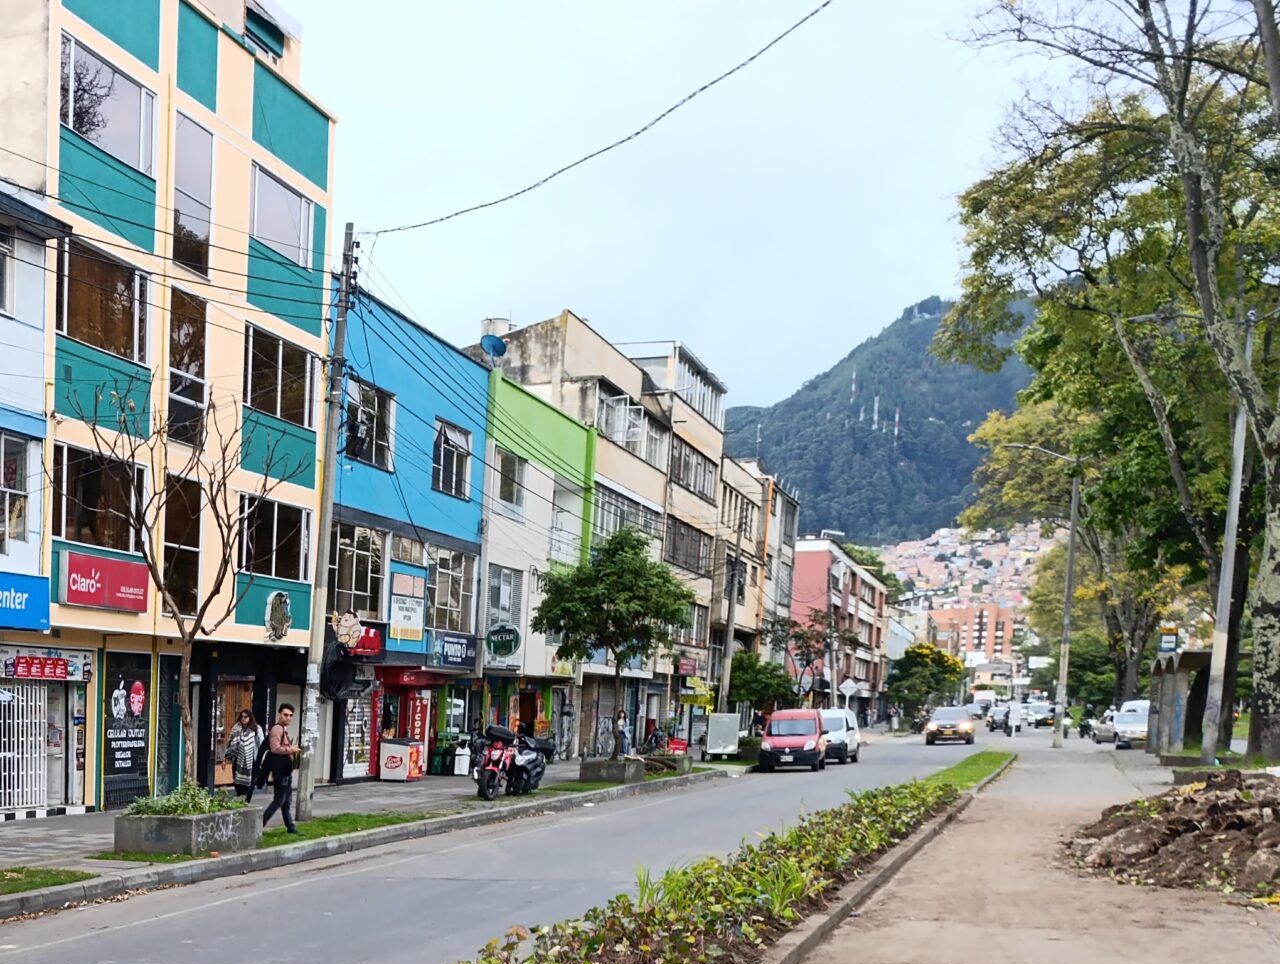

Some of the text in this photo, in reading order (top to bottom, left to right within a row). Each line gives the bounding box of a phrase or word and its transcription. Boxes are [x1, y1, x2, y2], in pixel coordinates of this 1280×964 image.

[70, 571, 99, 593] Claro
[107, 728, 146, 738] CELULAR OUTLET
